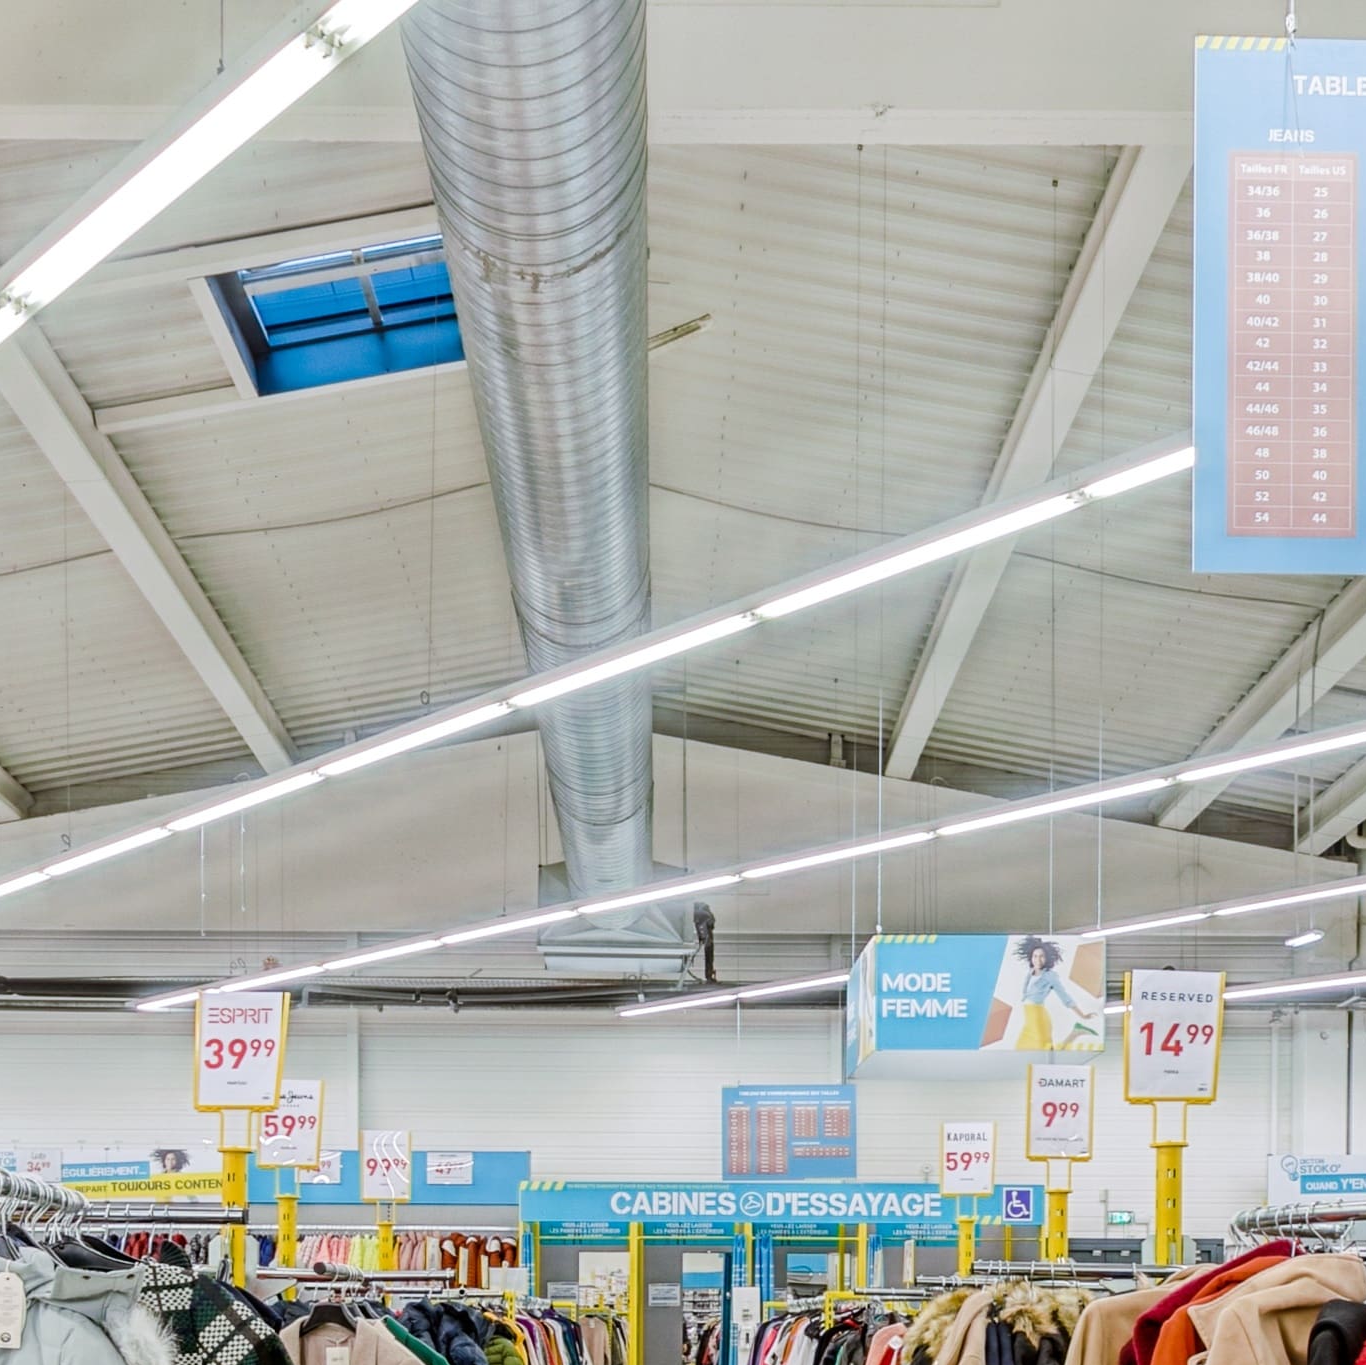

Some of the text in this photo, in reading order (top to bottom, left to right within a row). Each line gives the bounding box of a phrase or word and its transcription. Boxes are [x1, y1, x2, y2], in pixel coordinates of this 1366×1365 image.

[1268, 129, 1315, 142] JEANS
[1241, 164, 1287, 174] Tailles FR
[1299, 165, 1330, 175] Tailles
[1247, 186, 1280, 196] 34/36
[1247, 231, 1279, 240] 36/38
[1247, 272, 1279, 282] 38/40
[1246, 316, 1279, 327] 40/42
[1246, 361, 1279, 371] 42/44
[1246, 404, 1279, 414] 44/46
[1246, 426, 1278, 436] 46/48
[882, 973, 951, 992] MODE
[1141, 992, 1213, 1002] RESERVED
[882, 999, 967, 1018] FEMME
[208, 1008, 273, 1024] ESPRIT
[1140, 1023, 1213, 1056] 1499
[204, 1039, 275, 1069] 3999
[1038, 1078, 1085, 1088] DAMART
[1042, 1102, 1079, 1127] 999
[264, 1115, 317, 1138] 5999
[947, 1133, 987, 1141] KAPORAL
[946, 1152, 990, 1171] 5999
[111, 1181, 171, 1192] TOUJOURS
[1306, 1182, 1338, 1190] QUAND
[611, 1191, 942, 1217] CABINES D'ESSAYAGE
